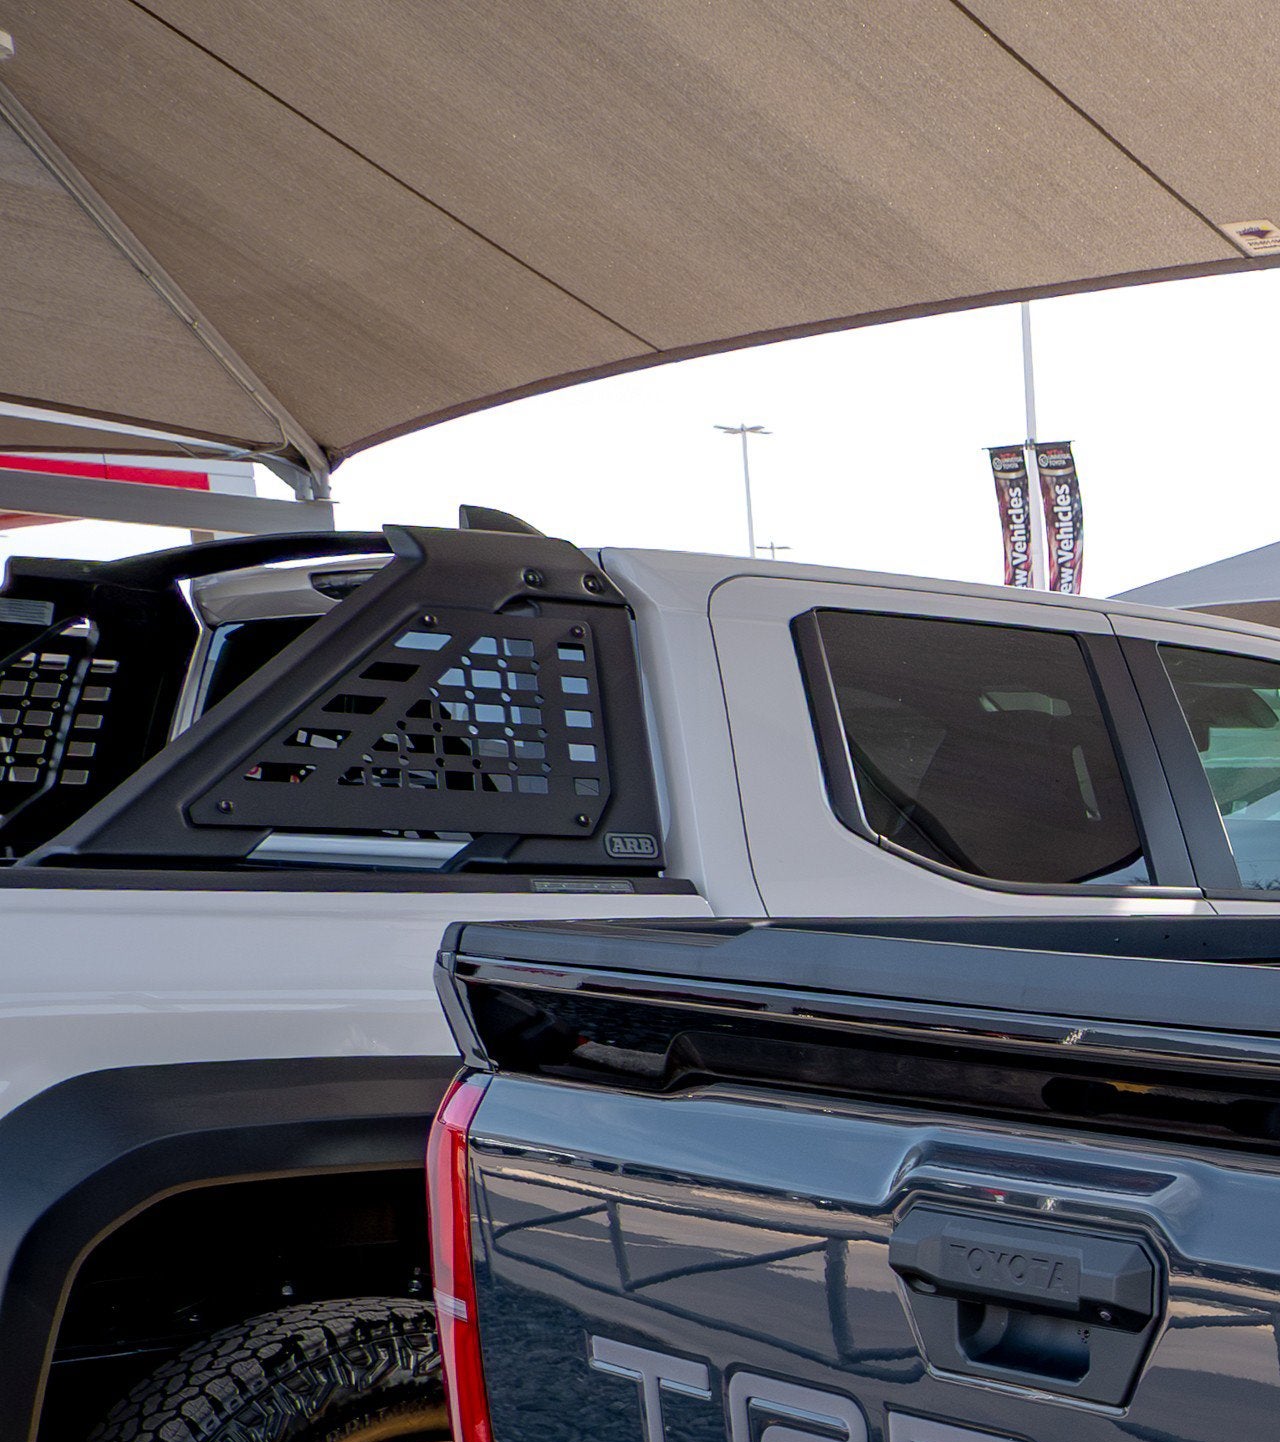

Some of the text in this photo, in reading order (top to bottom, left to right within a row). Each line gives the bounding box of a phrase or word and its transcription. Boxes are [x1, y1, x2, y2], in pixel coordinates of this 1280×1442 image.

[1007, 486, 1028, 566] Vehicles
[1053, 484, 1075, 594] ew Vehicles
[611, 837, 655, 854] ARB
[949, 1243, 1068, 1294] TOYOTA
